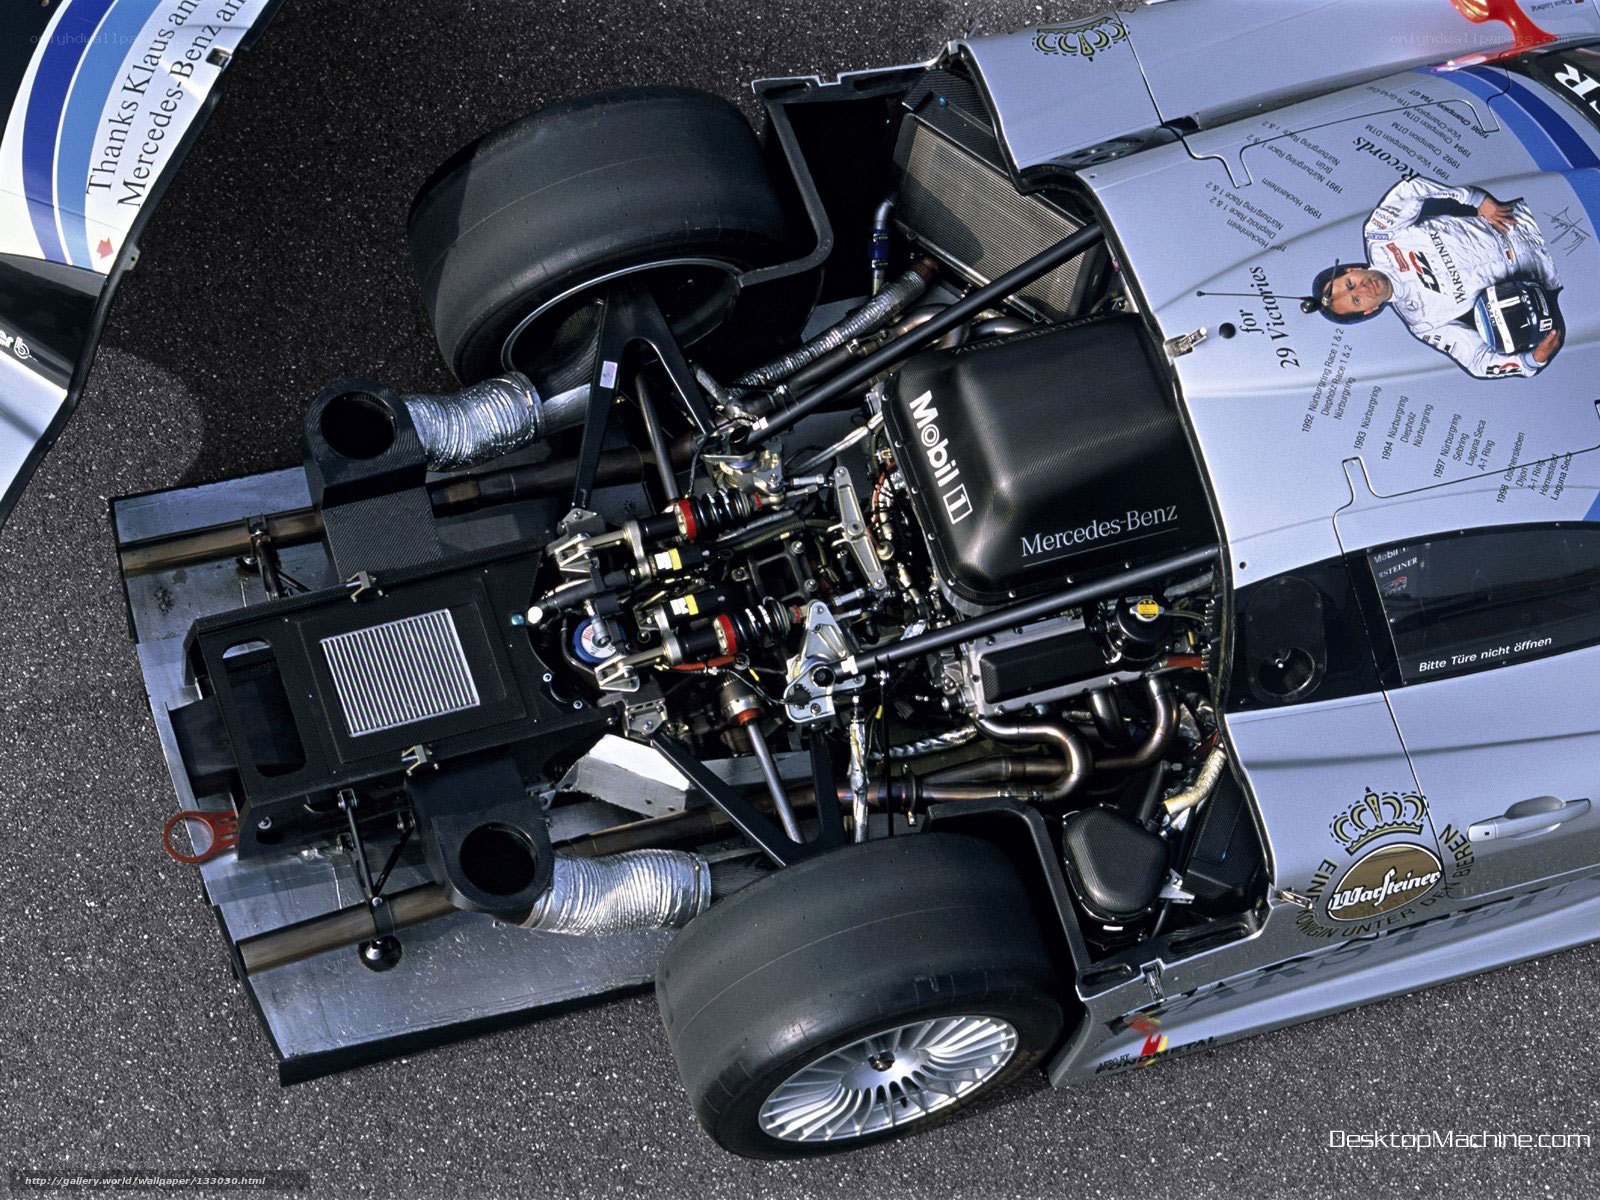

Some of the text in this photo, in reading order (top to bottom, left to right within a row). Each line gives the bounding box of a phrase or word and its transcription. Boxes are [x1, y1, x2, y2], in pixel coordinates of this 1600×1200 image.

[86, 0, 200, 195] Thanks Klaus an
[117, 0, 246, 207] Mercedes-Benz an
[1402, 110, 1472, 158] 1994 Champion DTM
[1413, 105, 1461, 140] Vice-Champion
[1268, 145, 1284, 159] Race
[1301, 138, 1340, 166] Nürburgring
[1352, 136, 1421, 183] Records
[1365, 124, 1450, 181] 1991 Vice-Champion DTM
[1391, 121, 1461, 170] 1992 Champion DTM
[1286, 153, 1326, 183] Nürburgring
[1326, 180, 1344, 194] 1991
[1225, 192, 1242, 207] Race
[1229, 207, 1246, 222] Race
[1243, 201, 1284, 231] Nürburgring
[1262, 177, 1323, 220] 1990 Hockenheim
[1226, 218, 1269, 249] Hockenheim
[1244, 215, 1276, 240] Diepholz
[1430, 231, 1467, 304] WARSTEINER
[1240, 309, 1264, 334] for
[1250, 266, 1300, 369] 29 Victories
[1302, 414, 1314, 433] 1992
[1309, 367, 1328, 412] Nürburgring
[1325, 348, 1338, 368] Race
[1320, 384, 1337, 416] Diepholz
[1333, 365, 1346, 384] Race
[1334, 376, 1356, 420] Nürburgring
[909, 390, 960, 488] Mobil
[1354, 386, 1382, 449] 1993 Nürburgring
[1382, 395, 1409, 460] 1994 Nürburgring
[1400, 412, 1416, 444] Diepholz
[1412, 404, 1434, 448] Nürburgring
[1434, 414, 1462, 478] 1997 Nürburgring
[1452, 432, 1470, 462] Sebring
[1465, 420, 1486, 466] Laguna Seca
[1478, 440, 1496, 470] A-1 Ring
[1516, 467, 1528, 488] Dijon
[1528, 460, 1546, 492] A-1 Ring
[1539, 454, 1558, 496] Homestead
[1551, 452, 1573, 500] Laguna Seca
[1021, 504, 1178, 557] Mercedes-Benz
[1418, 636, 1552, 673] Bitte Türe nicht öffnen
[1327, 866, 1441, 912] Warsteiner
[1341, 908, 1416, 938] UNTER
